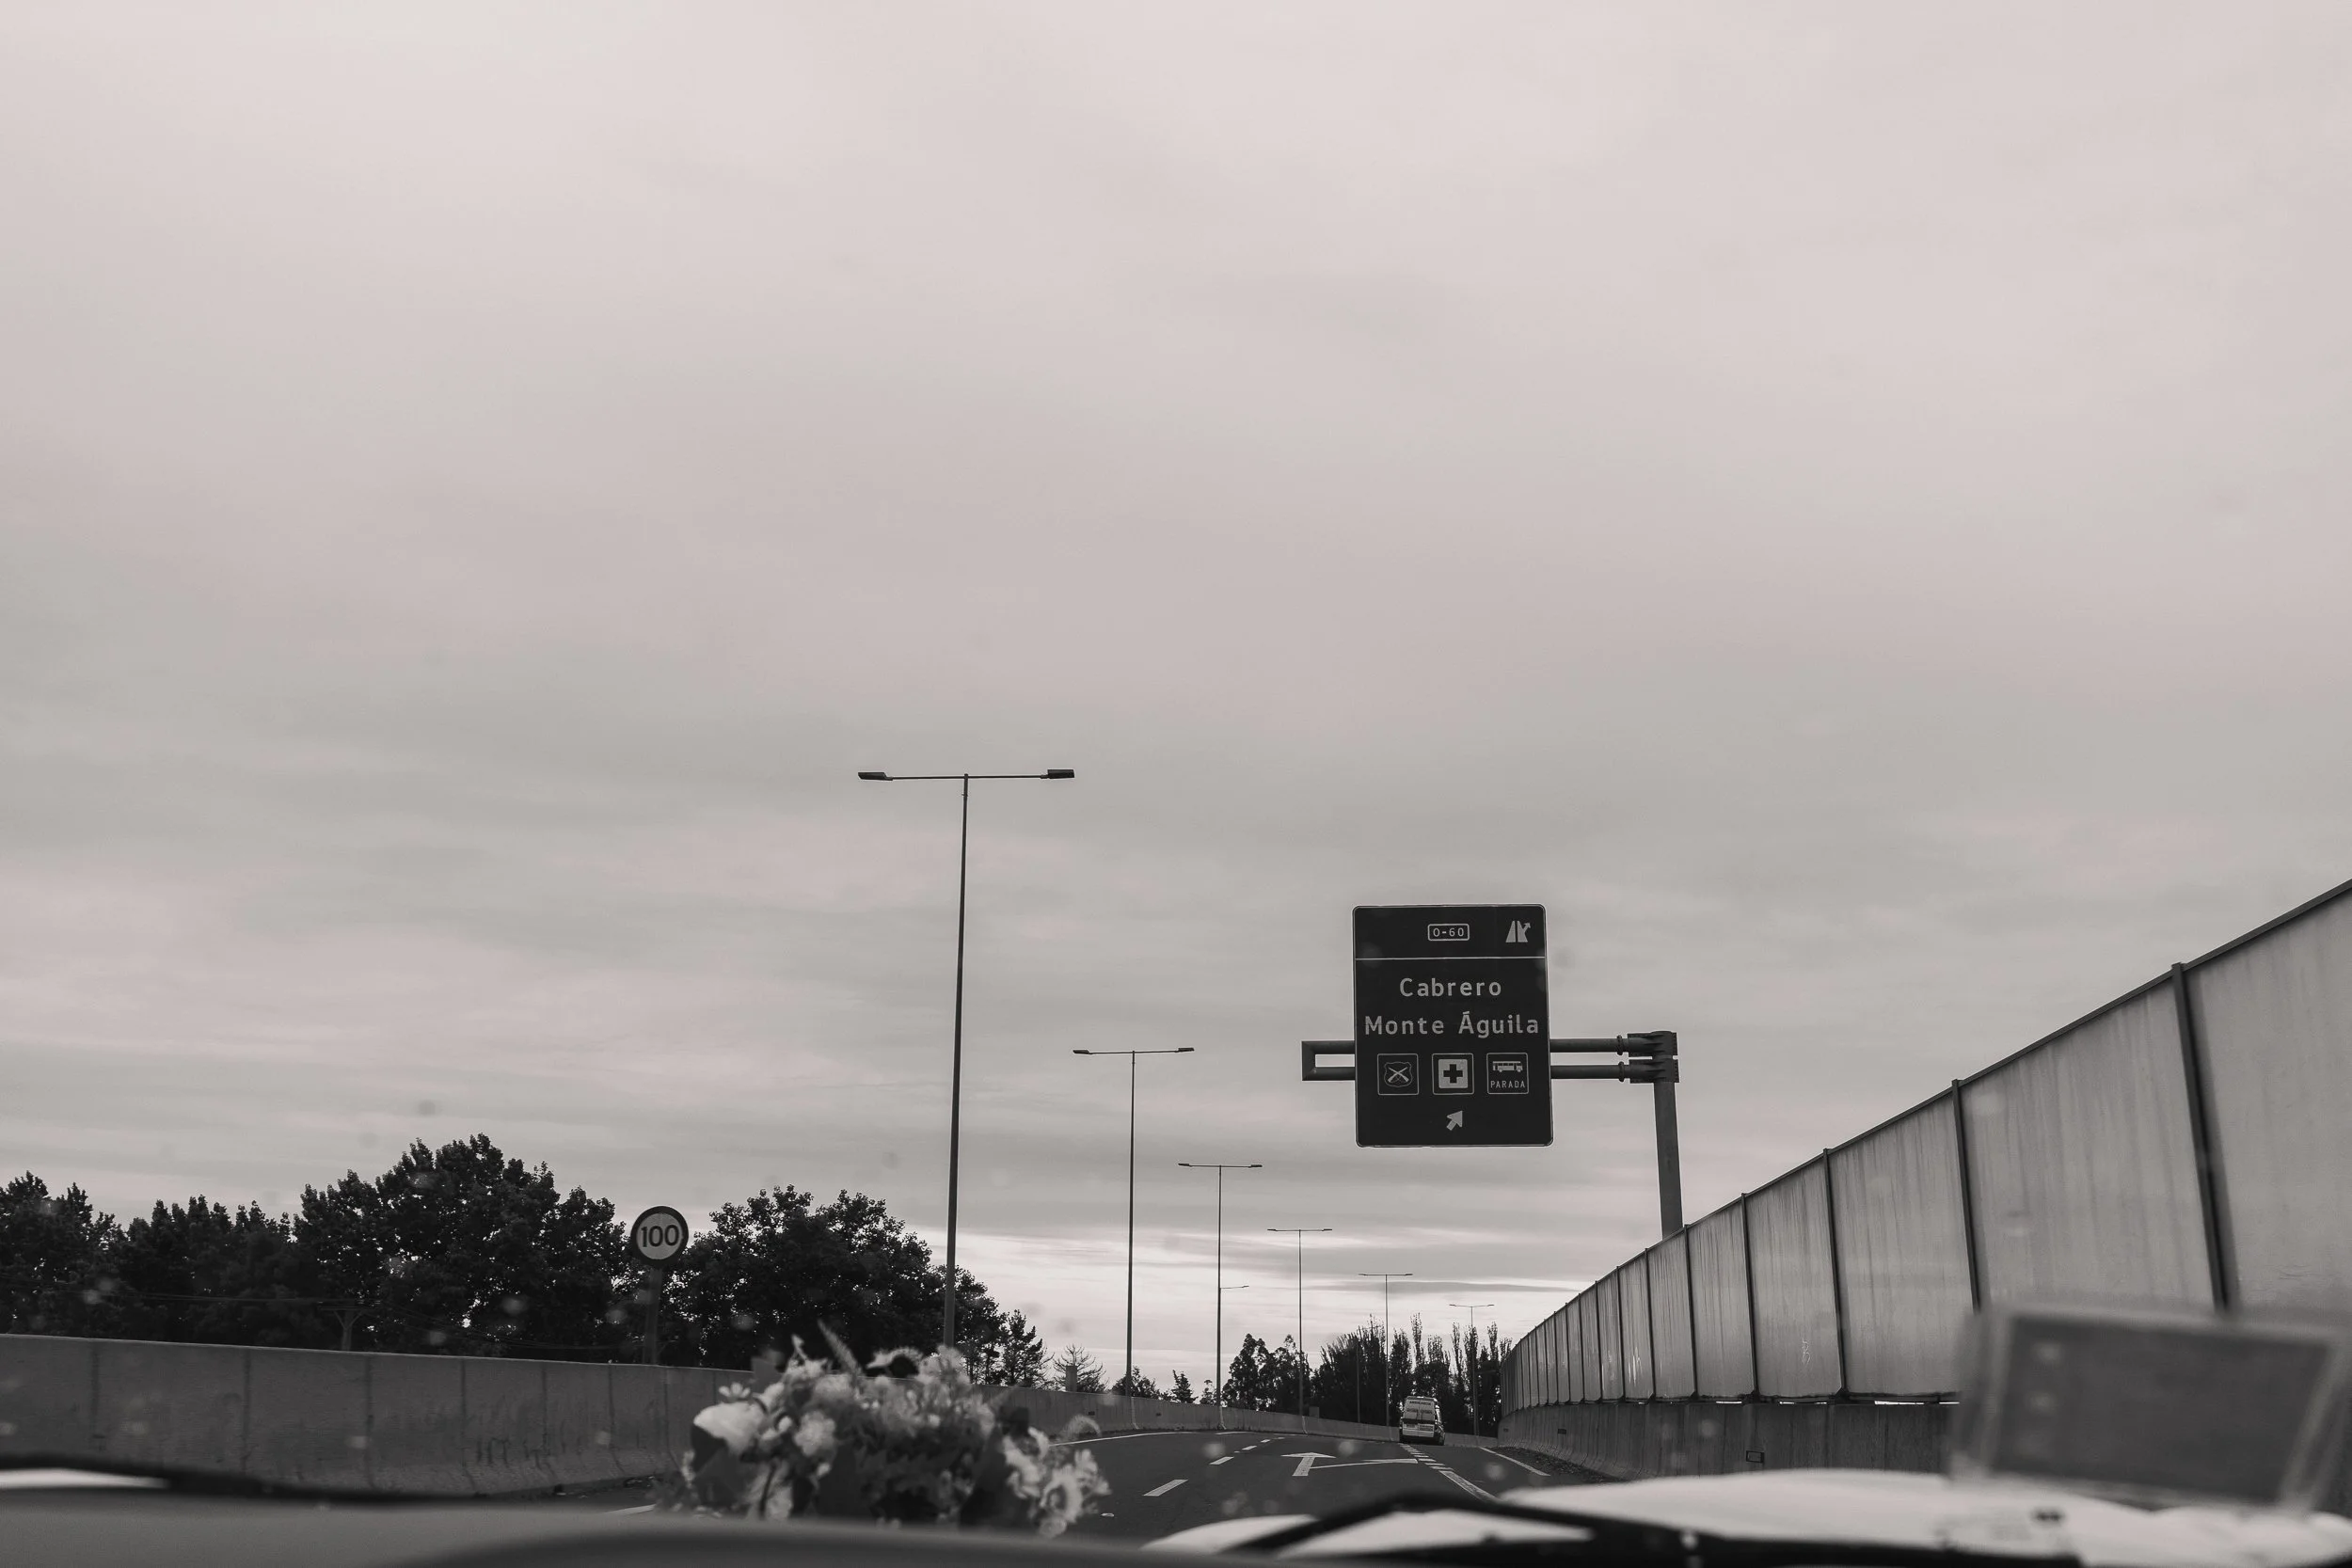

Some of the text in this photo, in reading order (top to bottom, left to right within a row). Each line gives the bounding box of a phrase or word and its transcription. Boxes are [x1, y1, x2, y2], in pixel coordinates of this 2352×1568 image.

[1399, 977, 1502, 997] Cabrero
[1365, 1010, 1538, 1038] Monte Águila
[1490, 1080, 1526, 1088] PARADA
[641, 1225, 679, 1247] 100
